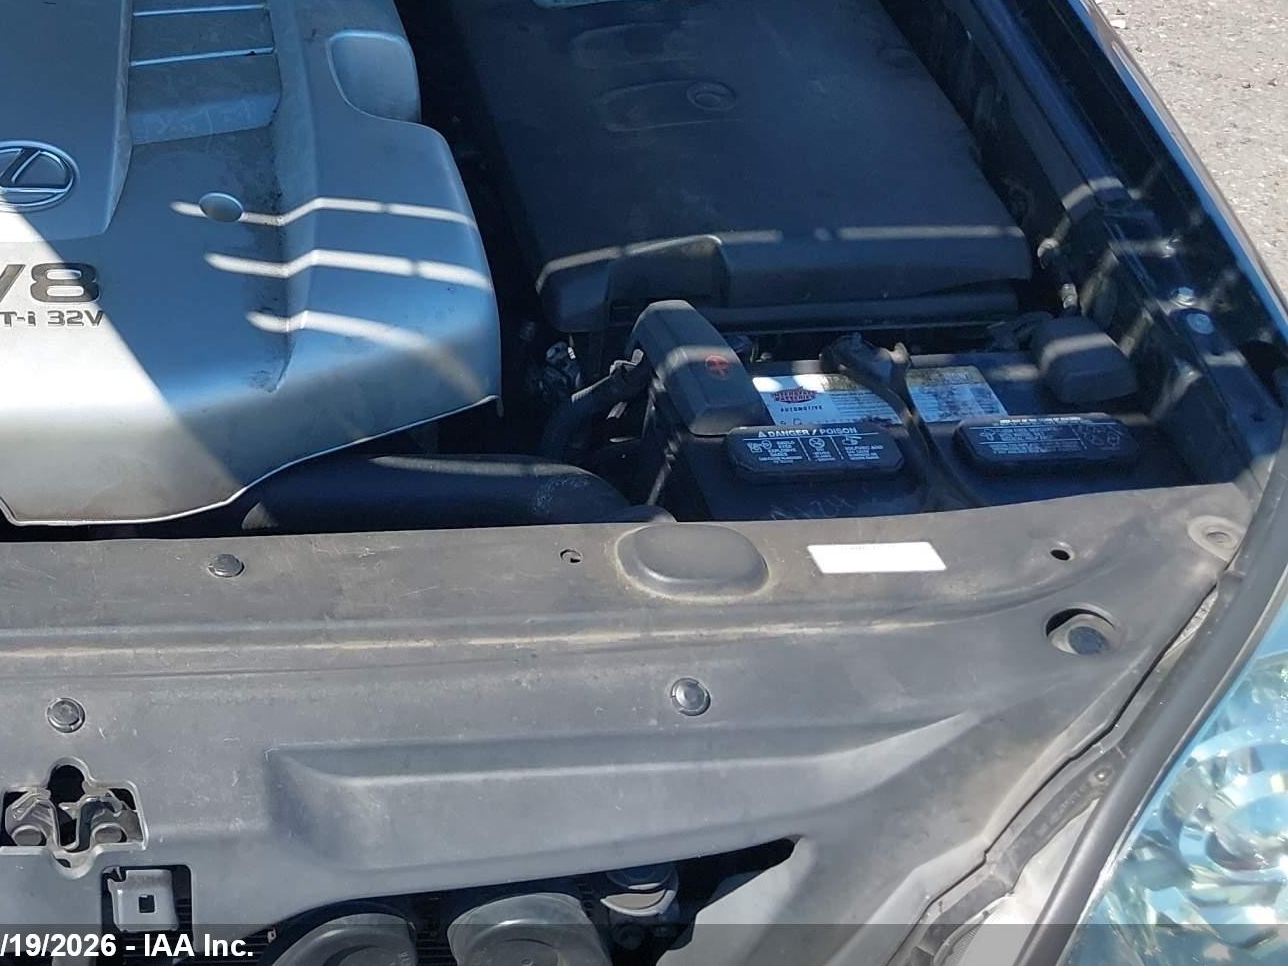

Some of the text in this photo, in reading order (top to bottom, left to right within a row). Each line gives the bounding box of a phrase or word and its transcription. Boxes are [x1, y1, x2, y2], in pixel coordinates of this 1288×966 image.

[47, 309, 104, 327] 32V
[767, 429, 810, 438] DANGER
[819, 427, 858, 435] POISON
